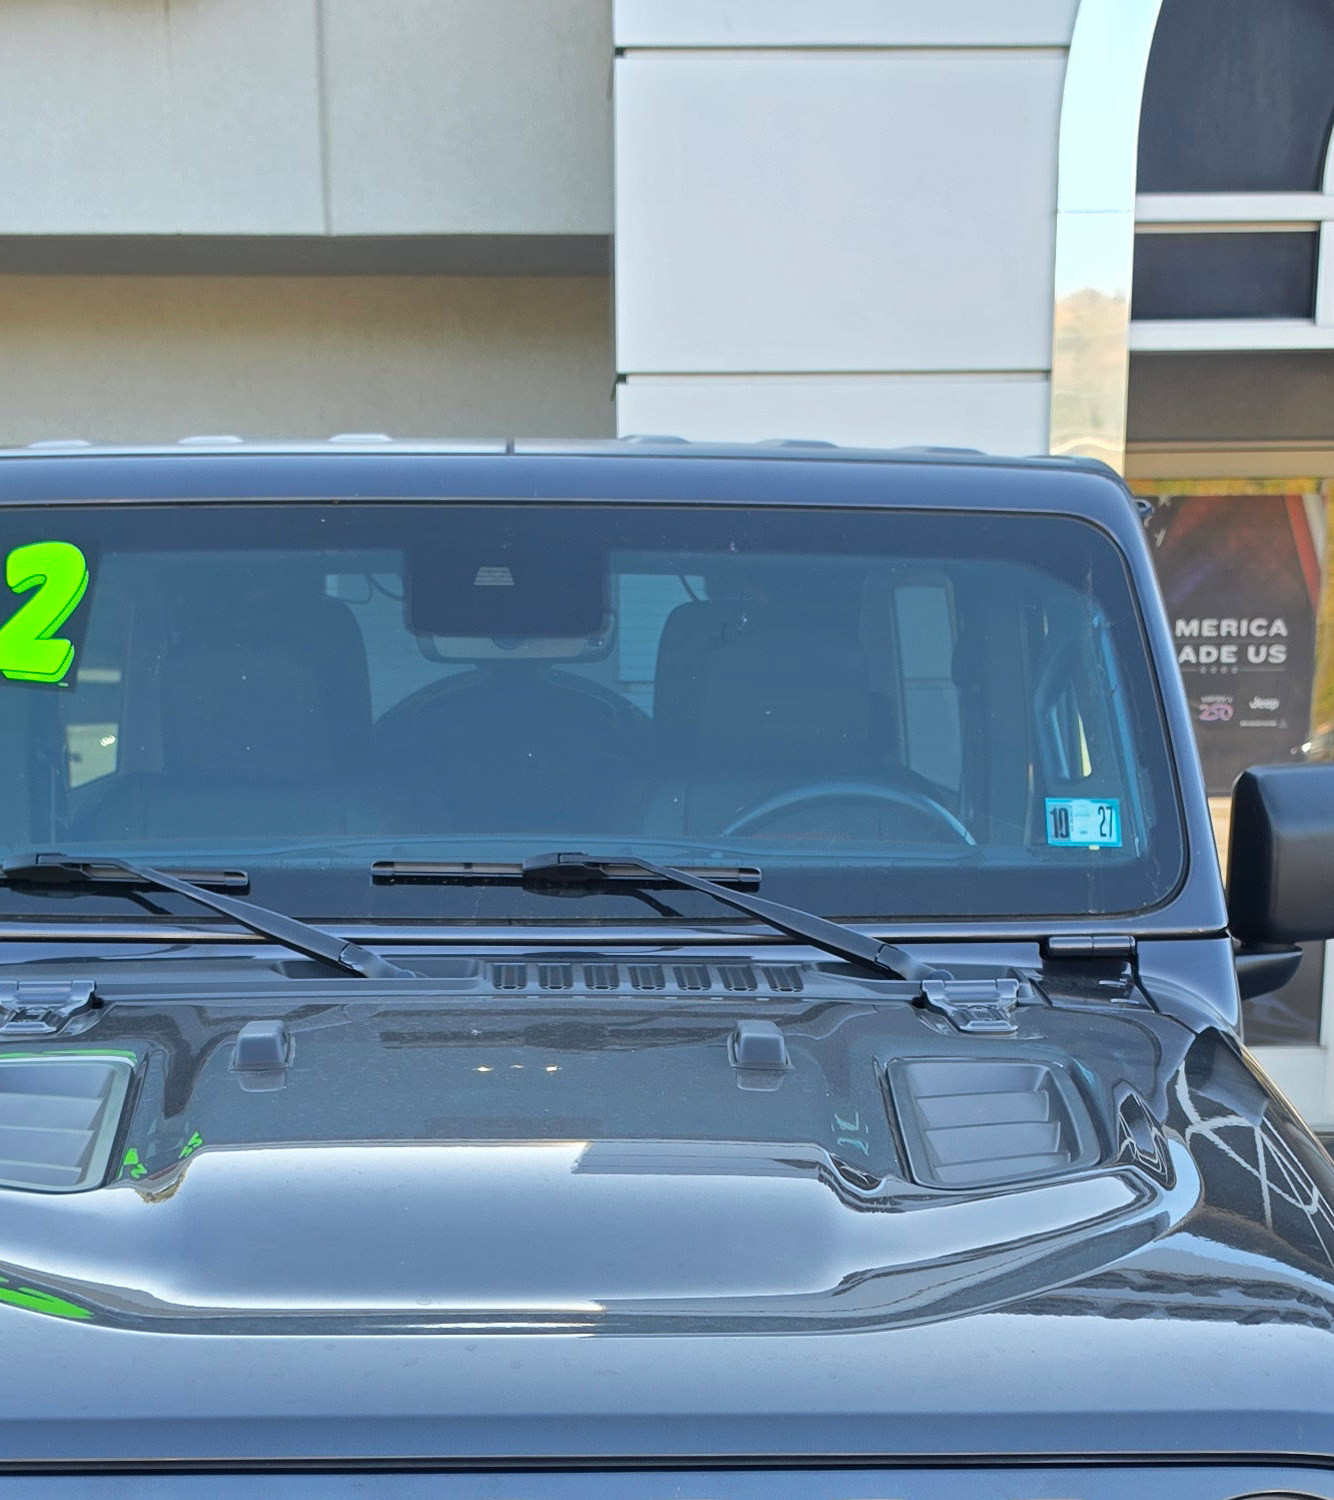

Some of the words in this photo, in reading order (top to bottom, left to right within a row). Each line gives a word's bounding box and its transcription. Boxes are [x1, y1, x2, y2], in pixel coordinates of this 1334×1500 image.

[1175, 618, 1288, 637] MERICA
[1179, 645, 1238, 663] ADE
[1247, 645, 1287, 664] US
[1050, 807, 1070, 838] 10
[1098, 806, 1113, 838] 27
